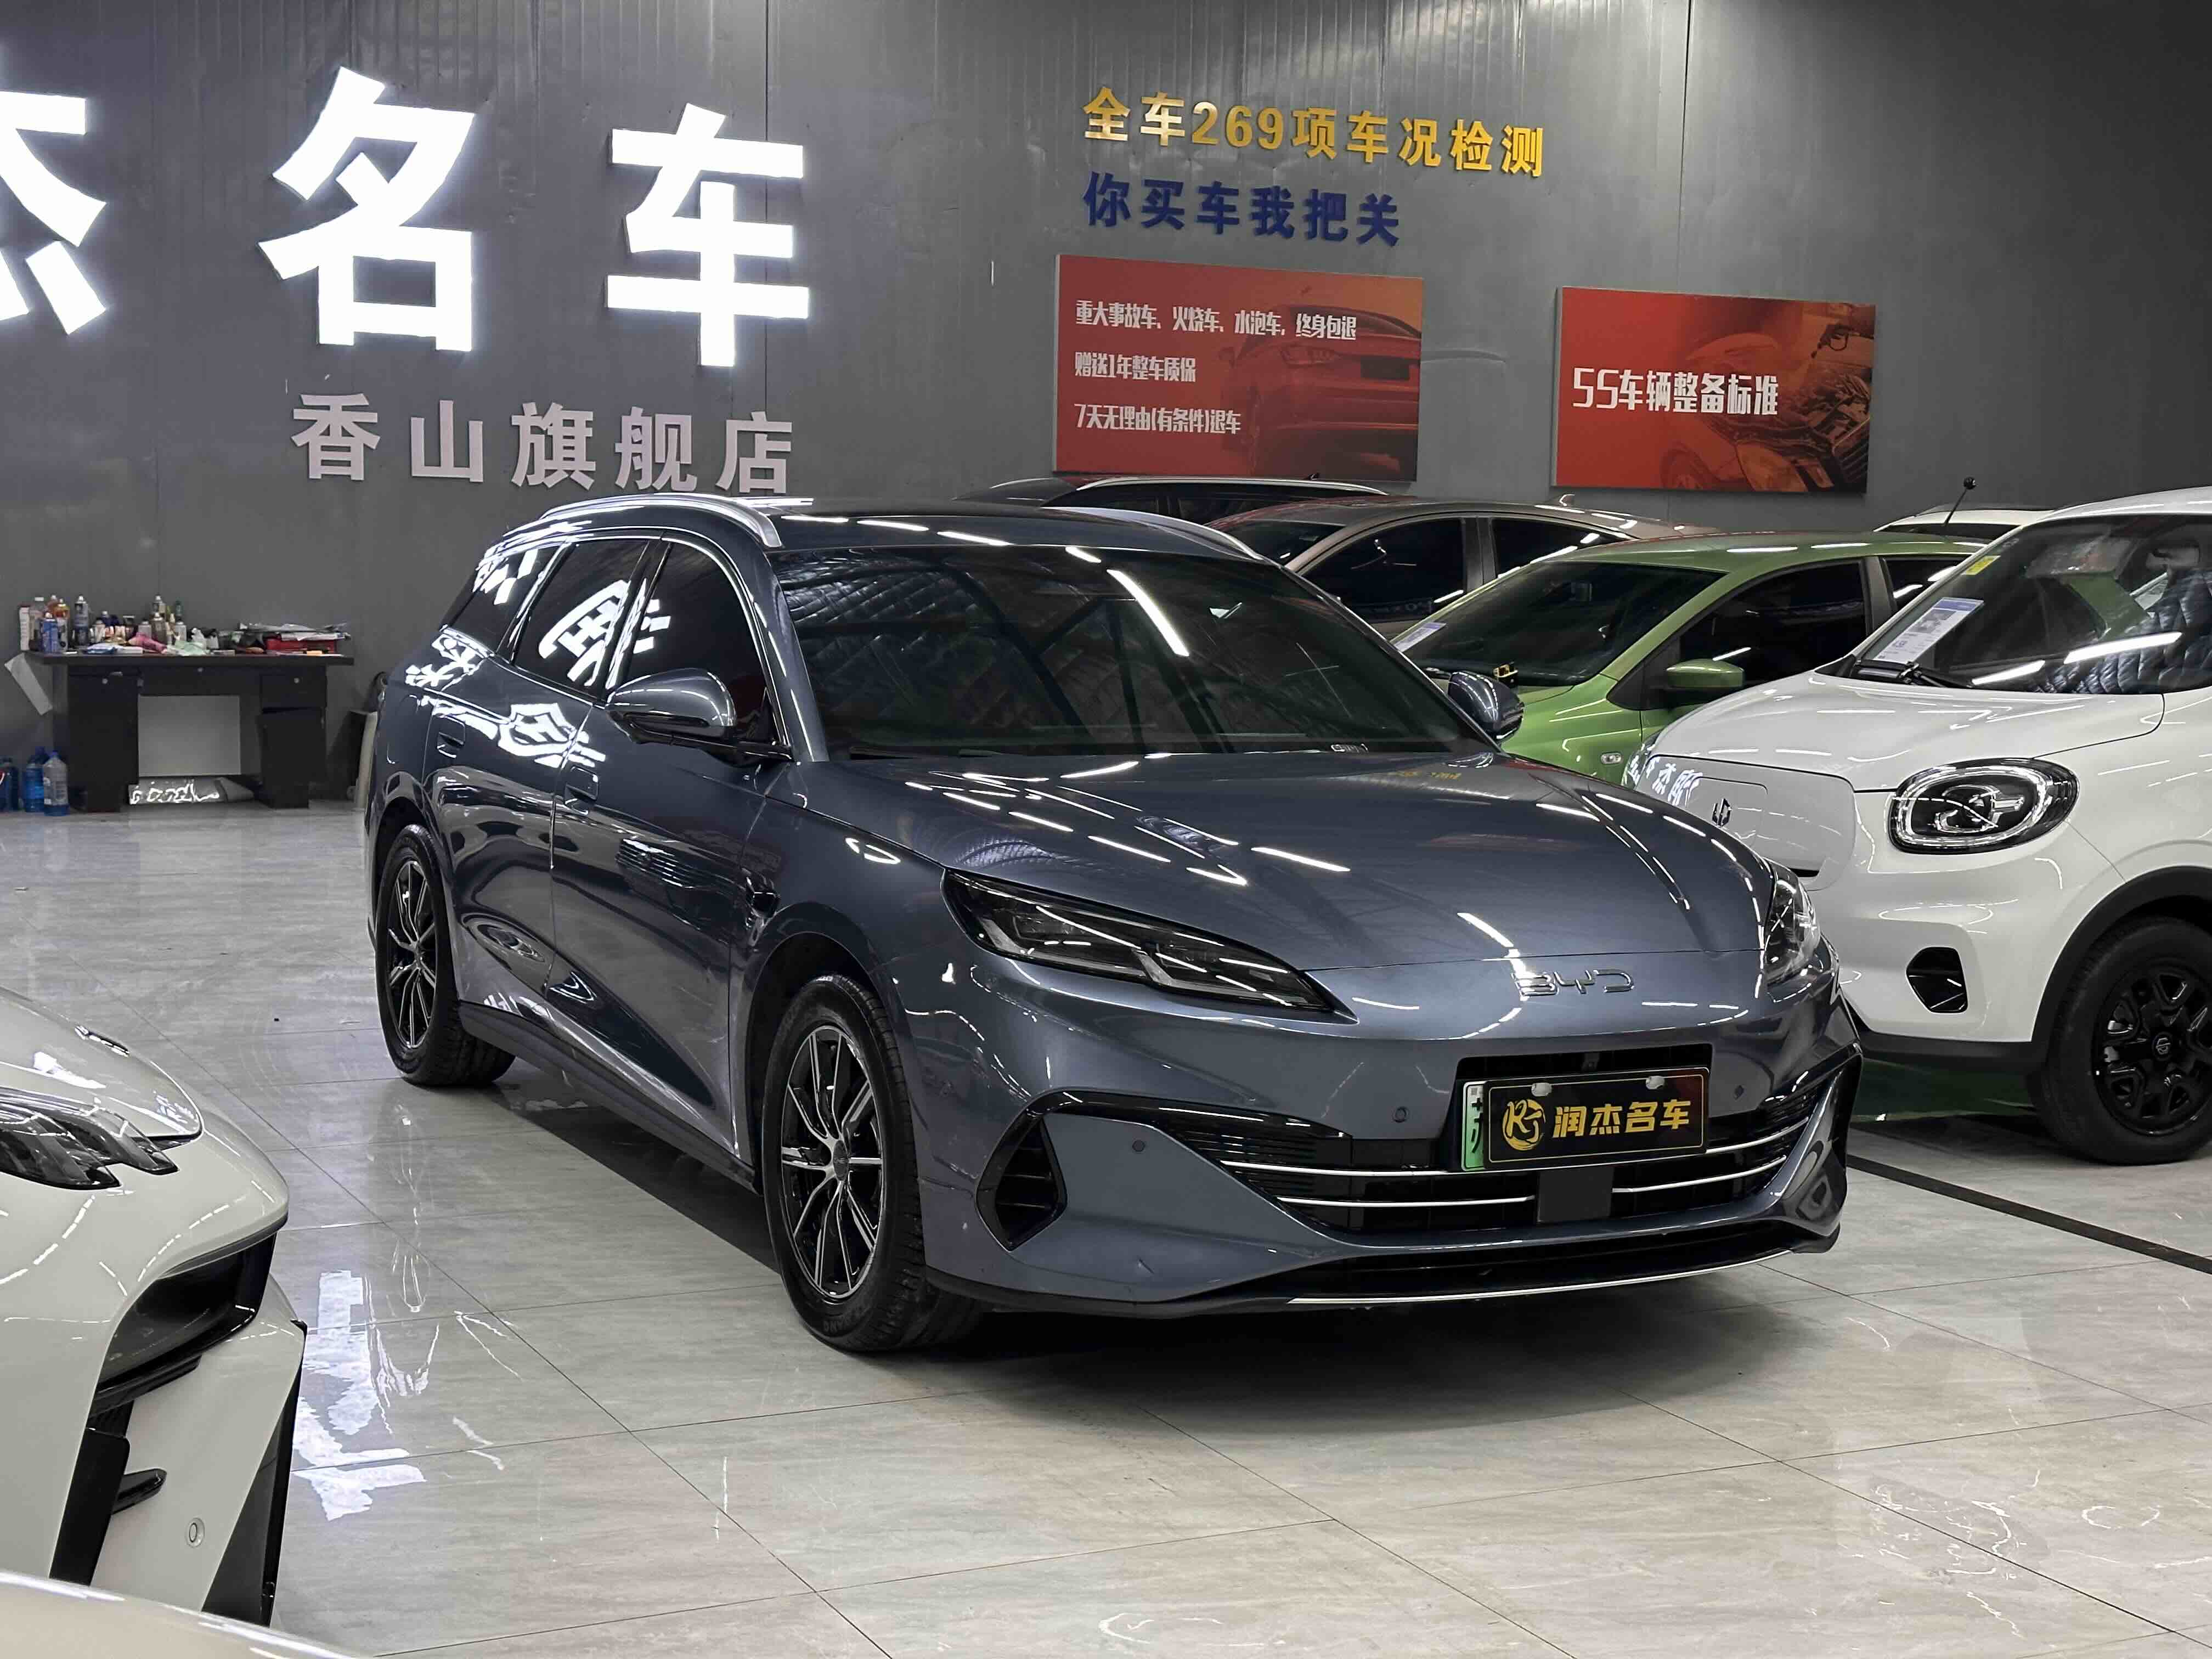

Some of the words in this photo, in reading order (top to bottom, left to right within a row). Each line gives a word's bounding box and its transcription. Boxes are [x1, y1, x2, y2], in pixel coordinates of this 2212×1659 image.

[1082, 86, 1543, 178] 全车269项车况检测
[1083, 171, 1400, 246] 你买车我把关
[1074, 352, 1197, 382] 赠送1年整车质保
[1572, 368, 1779, 415] 5S车辆整备标准
[292, 393, 793, 495] 香山旗舰店
[1517, 968, 1635, 996] BYD
[1553, 1099, 1691, 1138] 润杰名车
